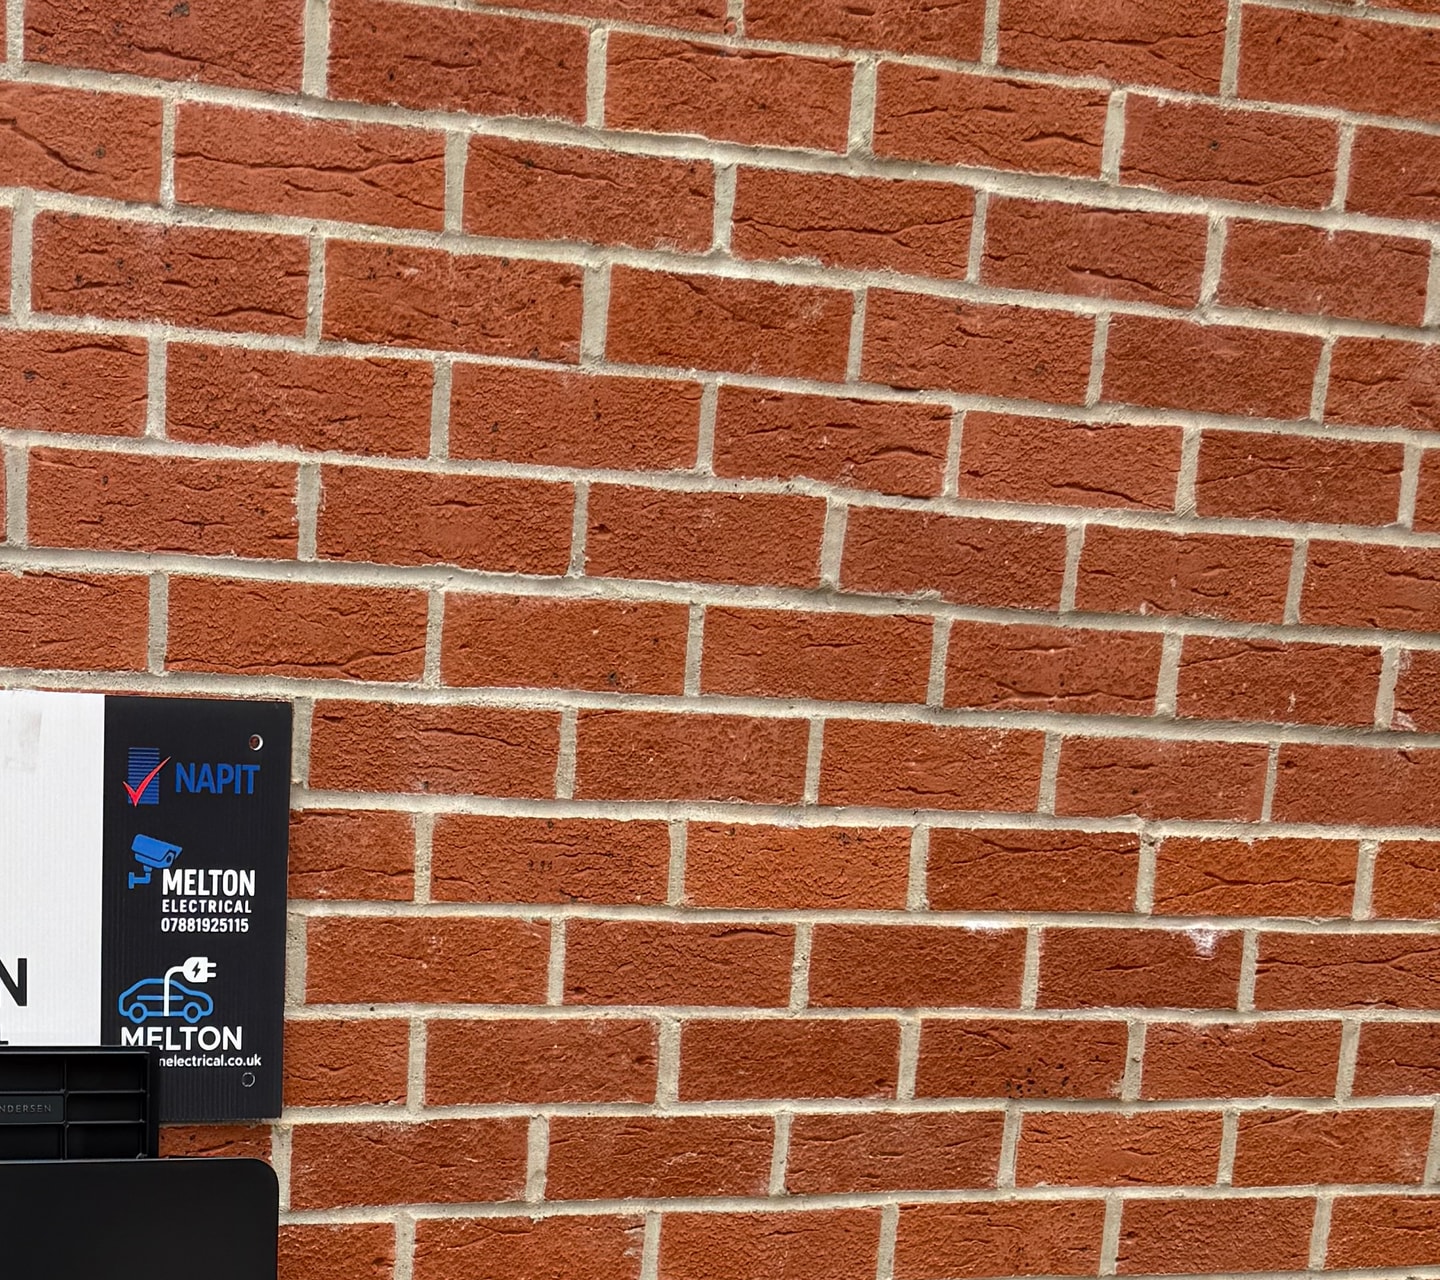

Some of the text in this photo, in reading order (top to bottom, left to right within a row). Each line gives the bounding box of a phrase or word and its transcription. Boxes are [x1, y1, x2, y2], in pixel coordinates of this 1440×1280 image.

[175, 762, 260, 794] NAPIT
[162, 868, 255, 896] MELTON
[161, 899, 252, 913] ELECTRICAL
[160, 917, 249, 933] 07881925115
[120, 1025, 243, 1051] MELTON
[159, 1053, 262, 1067] nelectrical.co.uk
